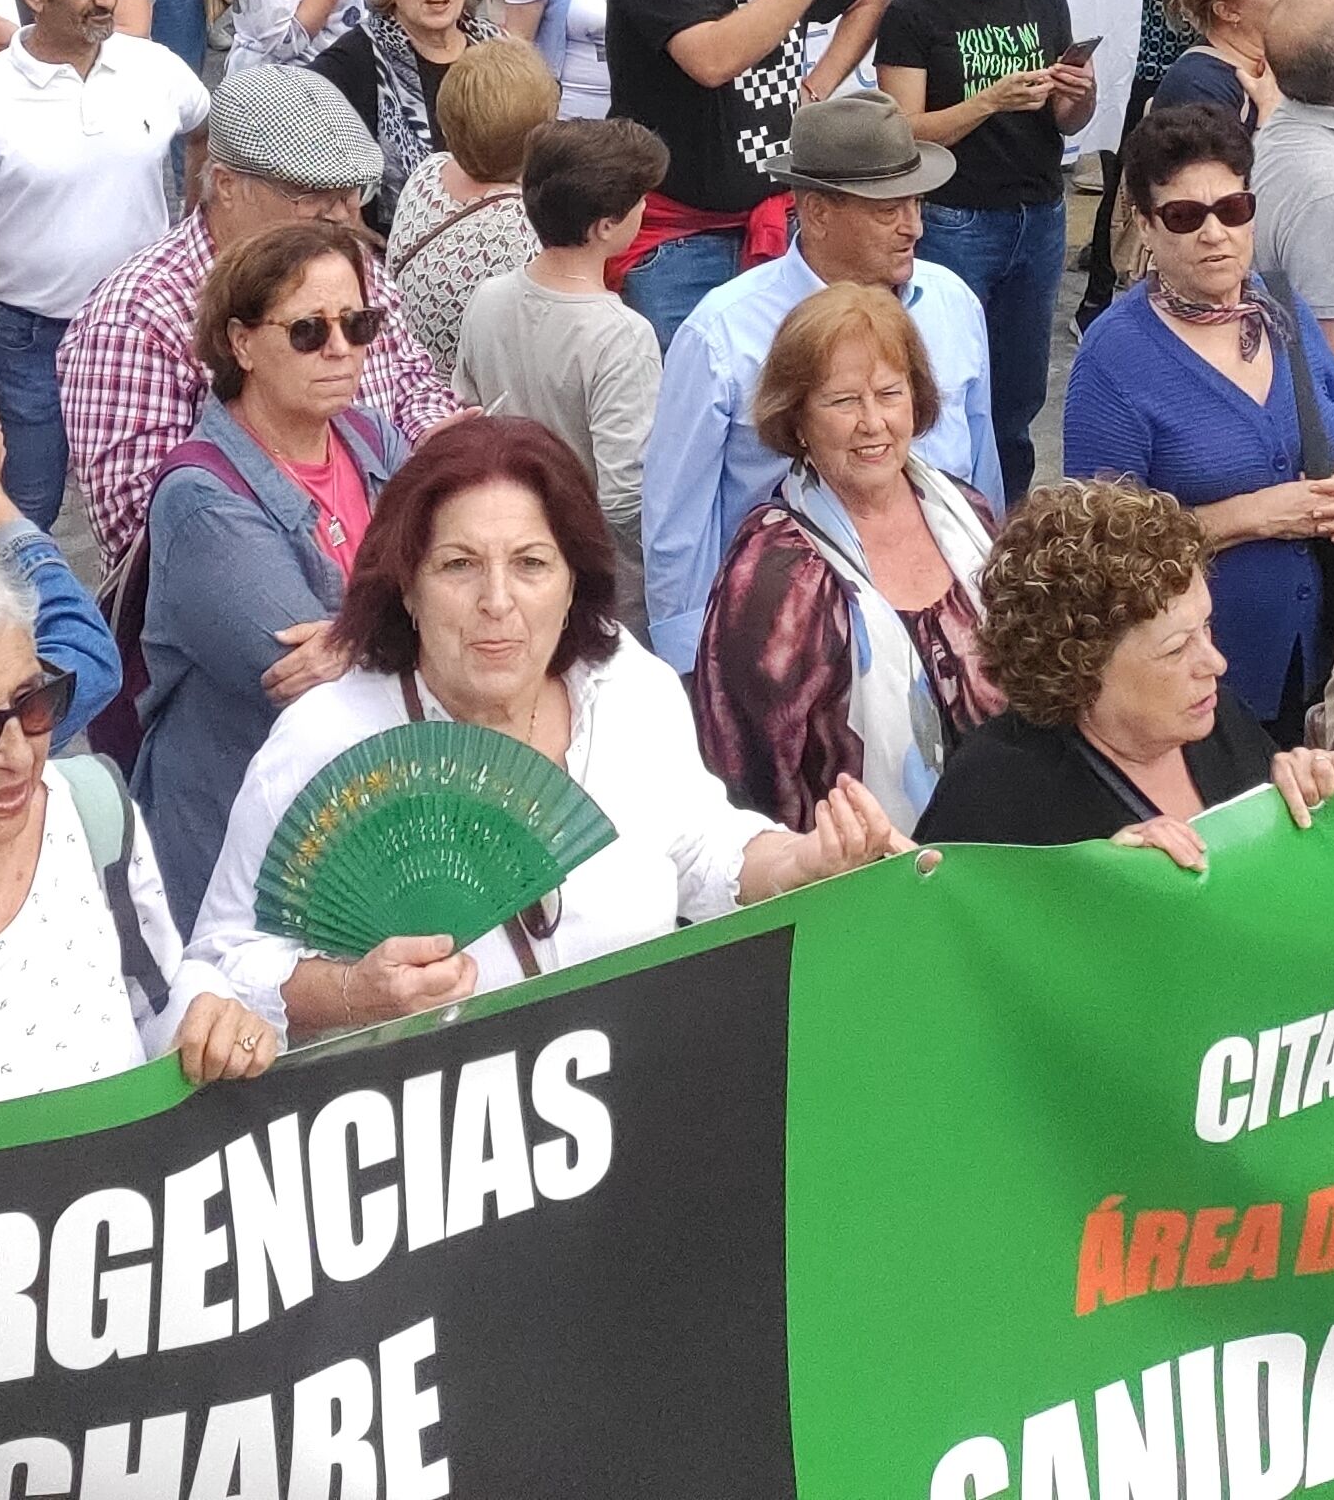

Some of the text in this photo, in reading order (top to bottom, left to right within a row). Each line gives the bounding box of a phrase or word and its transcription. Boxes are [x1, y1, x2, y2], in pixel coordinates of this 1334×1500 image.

[955, 21, 1040, 55] YOU'RE MY
[1074, 1193, 1283, 1318] ÁREA
